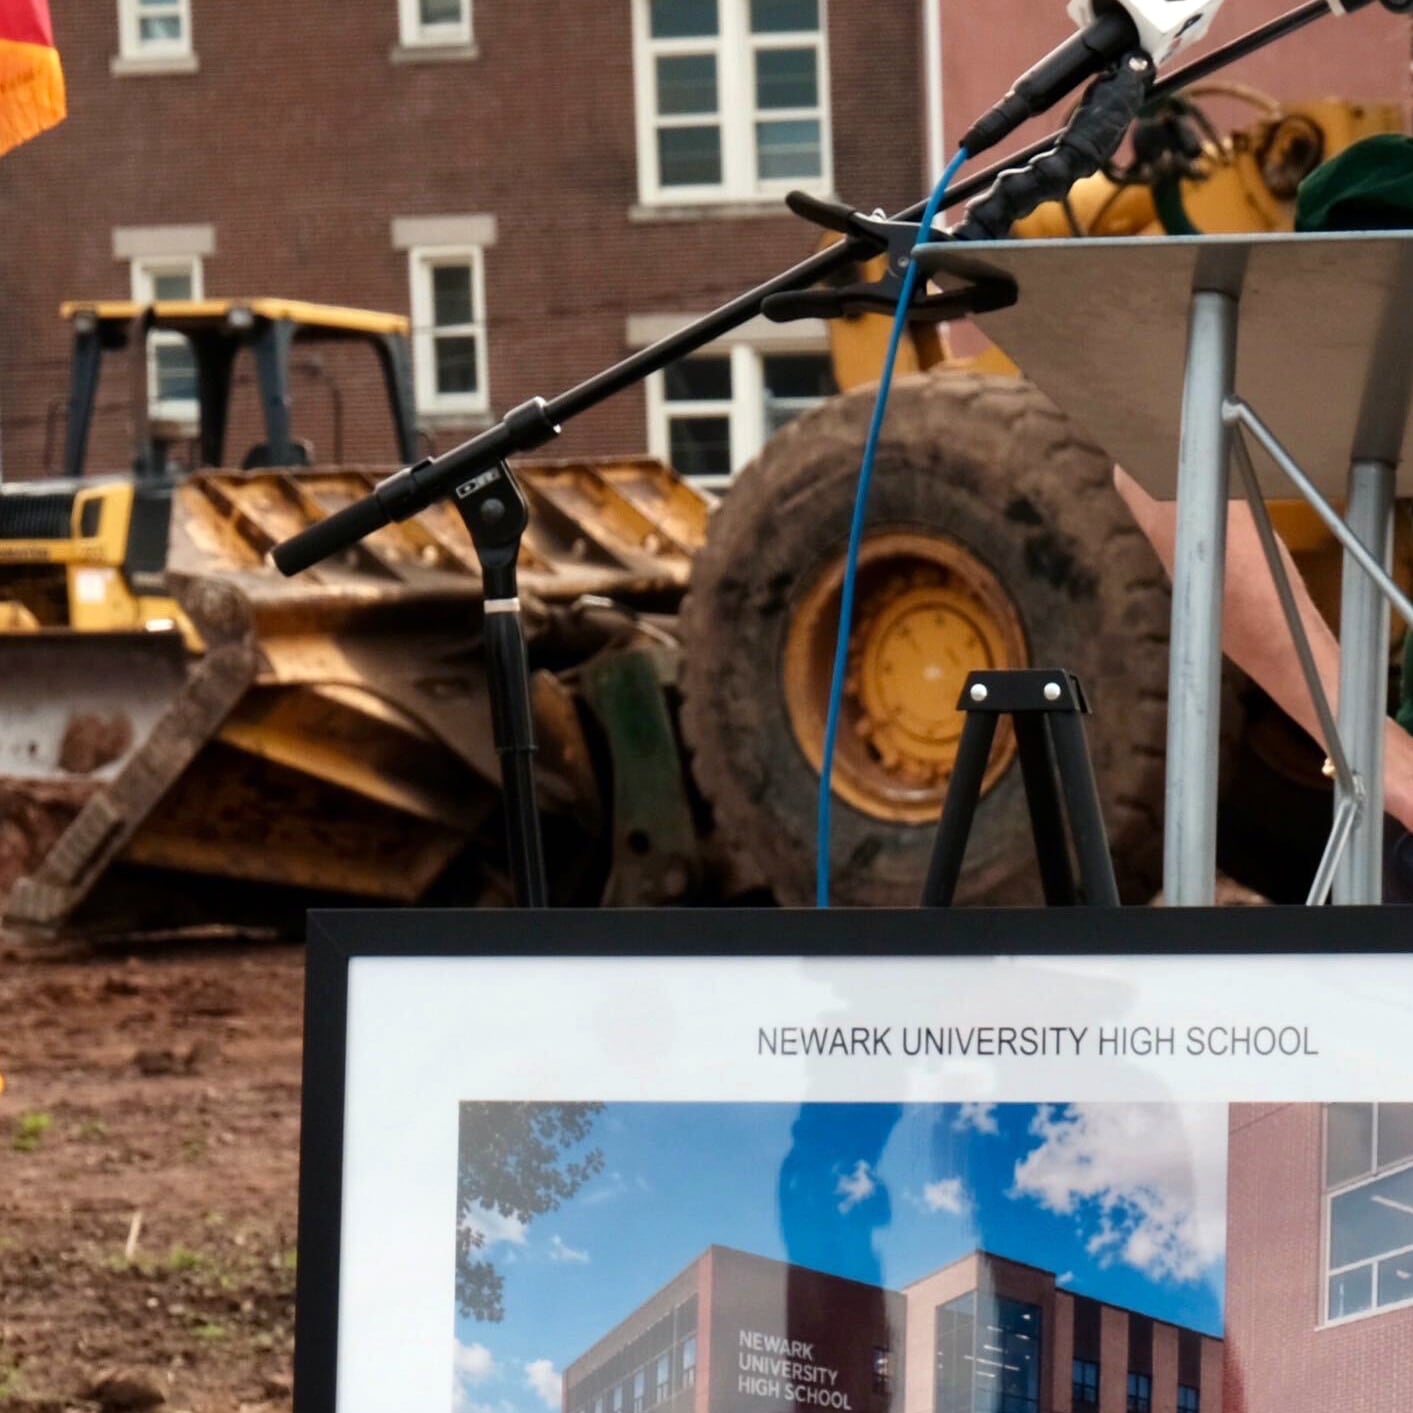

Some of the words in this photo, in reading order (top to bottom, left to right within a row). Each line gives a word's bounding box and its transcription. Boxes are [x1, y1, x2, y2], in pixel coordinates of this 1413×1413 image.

[757, 1026, 891, 1056] NEWARK
[902, 1026, 1089, 1056] UNIVERSITY
[1098, 1026, 1175, 1056] HIGH
[1186, 1026, 1320, 1056] SCHOOL
[739, 1330, 814, 1361] NEWARK
[738, 1352, 838, 1386] UNIVERSITY
[738, 1375, 780, 1399] HIGH
[784, 1383, 852, 1410] SCHOOL
